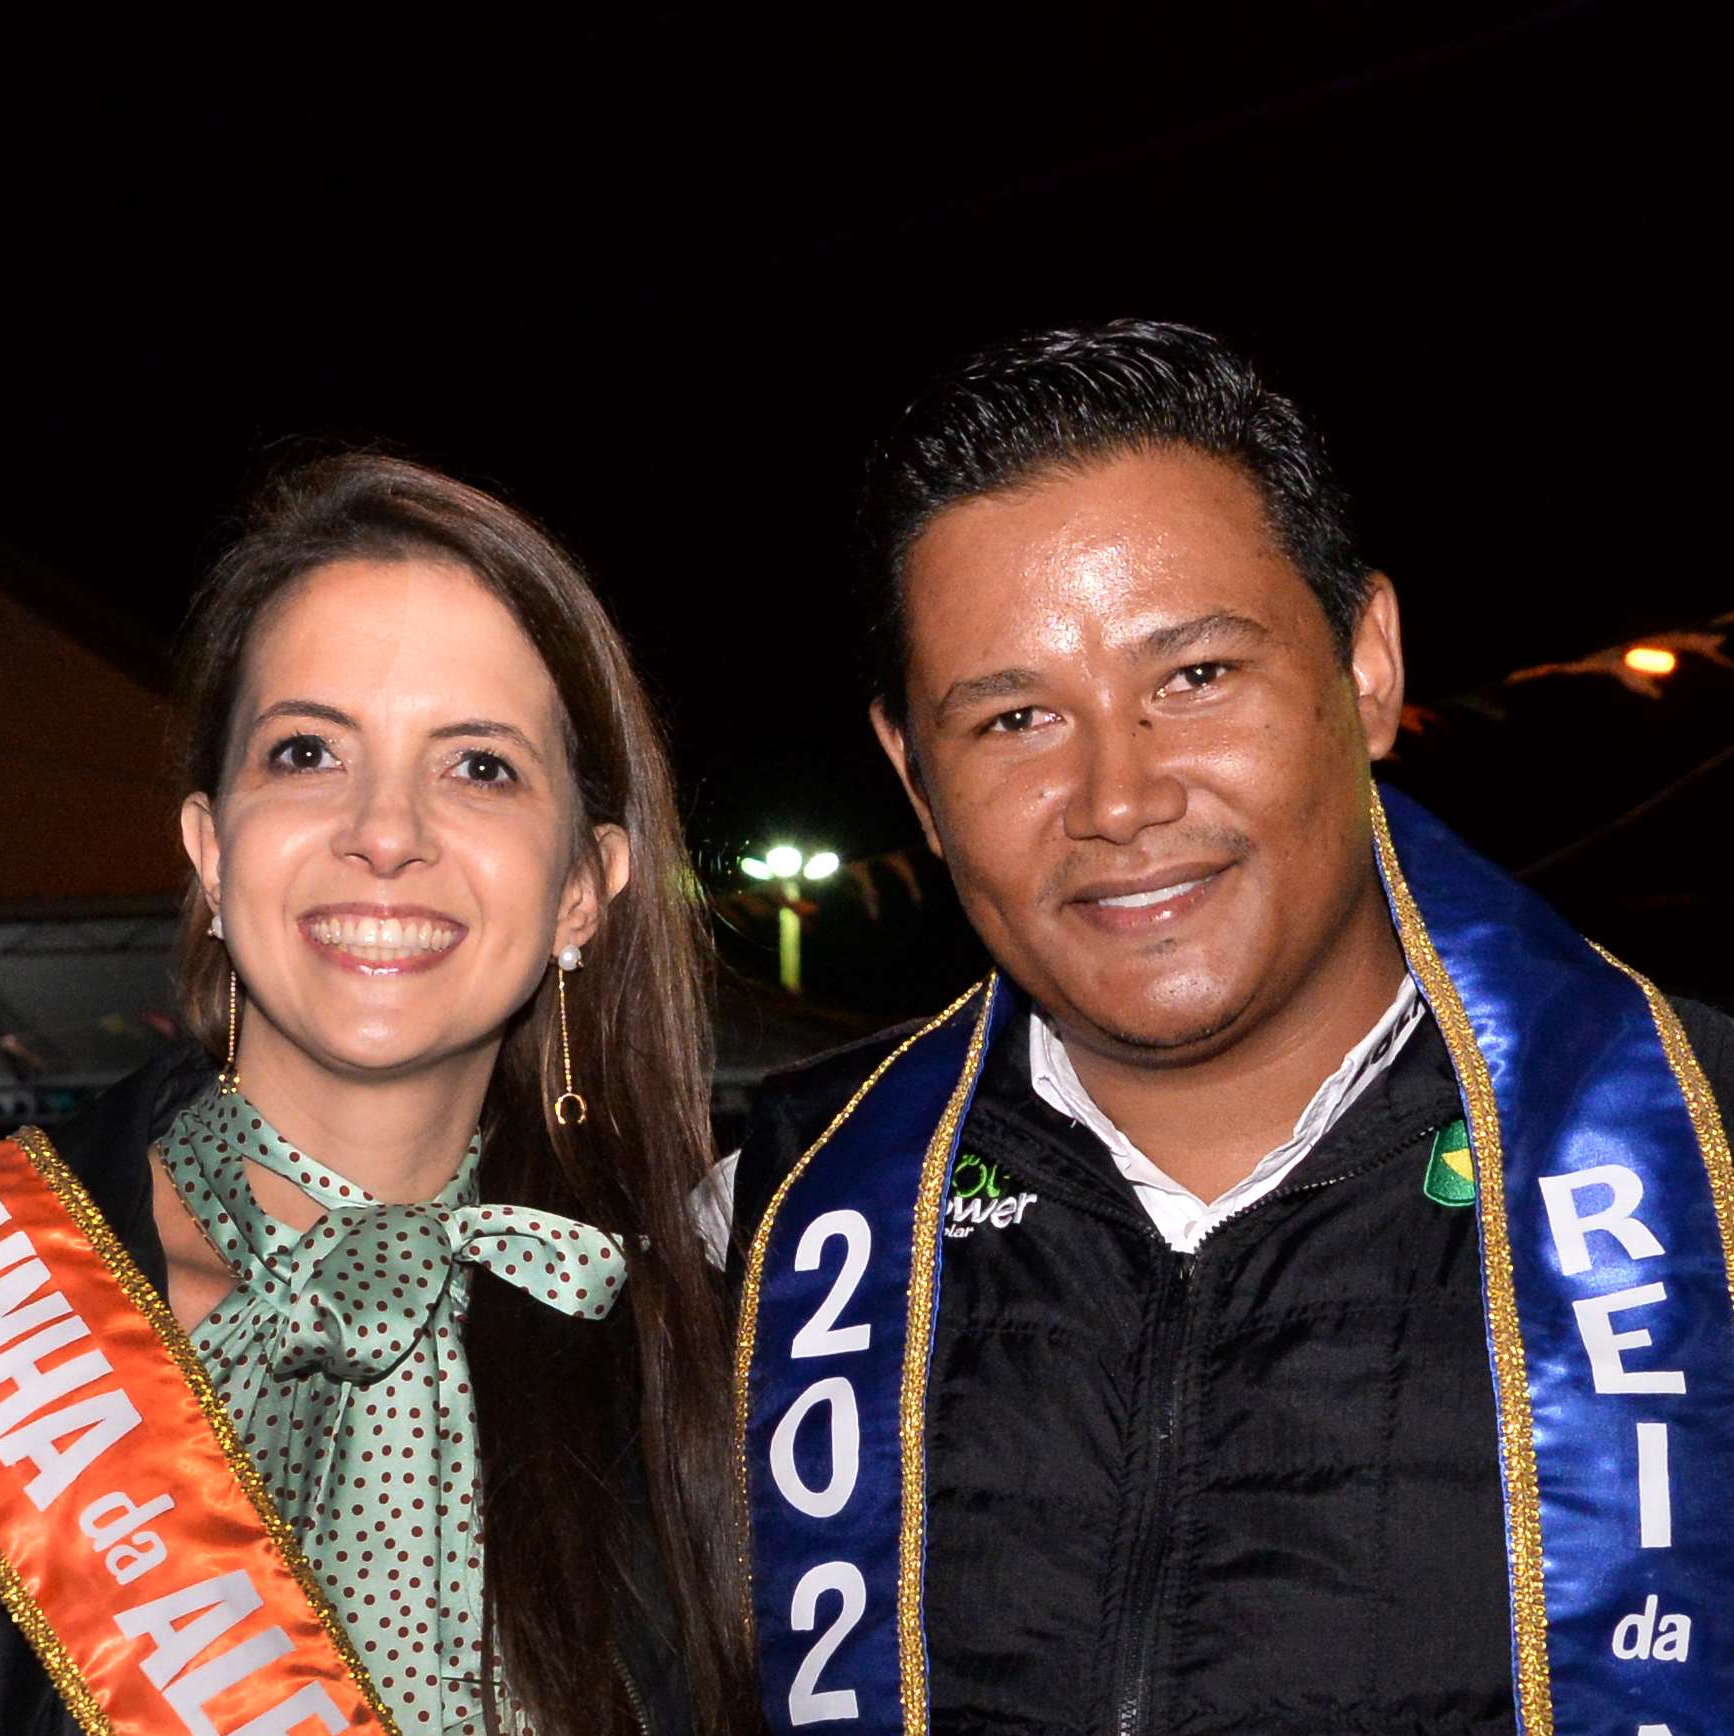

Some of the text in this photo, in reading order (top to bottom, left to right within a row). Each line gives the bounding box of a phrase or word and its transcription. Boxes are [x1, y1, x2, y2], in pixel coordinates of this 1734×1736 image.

[1538, 1163, 1687, 1549] REI
[78, 1491, 176, 1588] da
[1612, 1594, 1692, 1663] da
